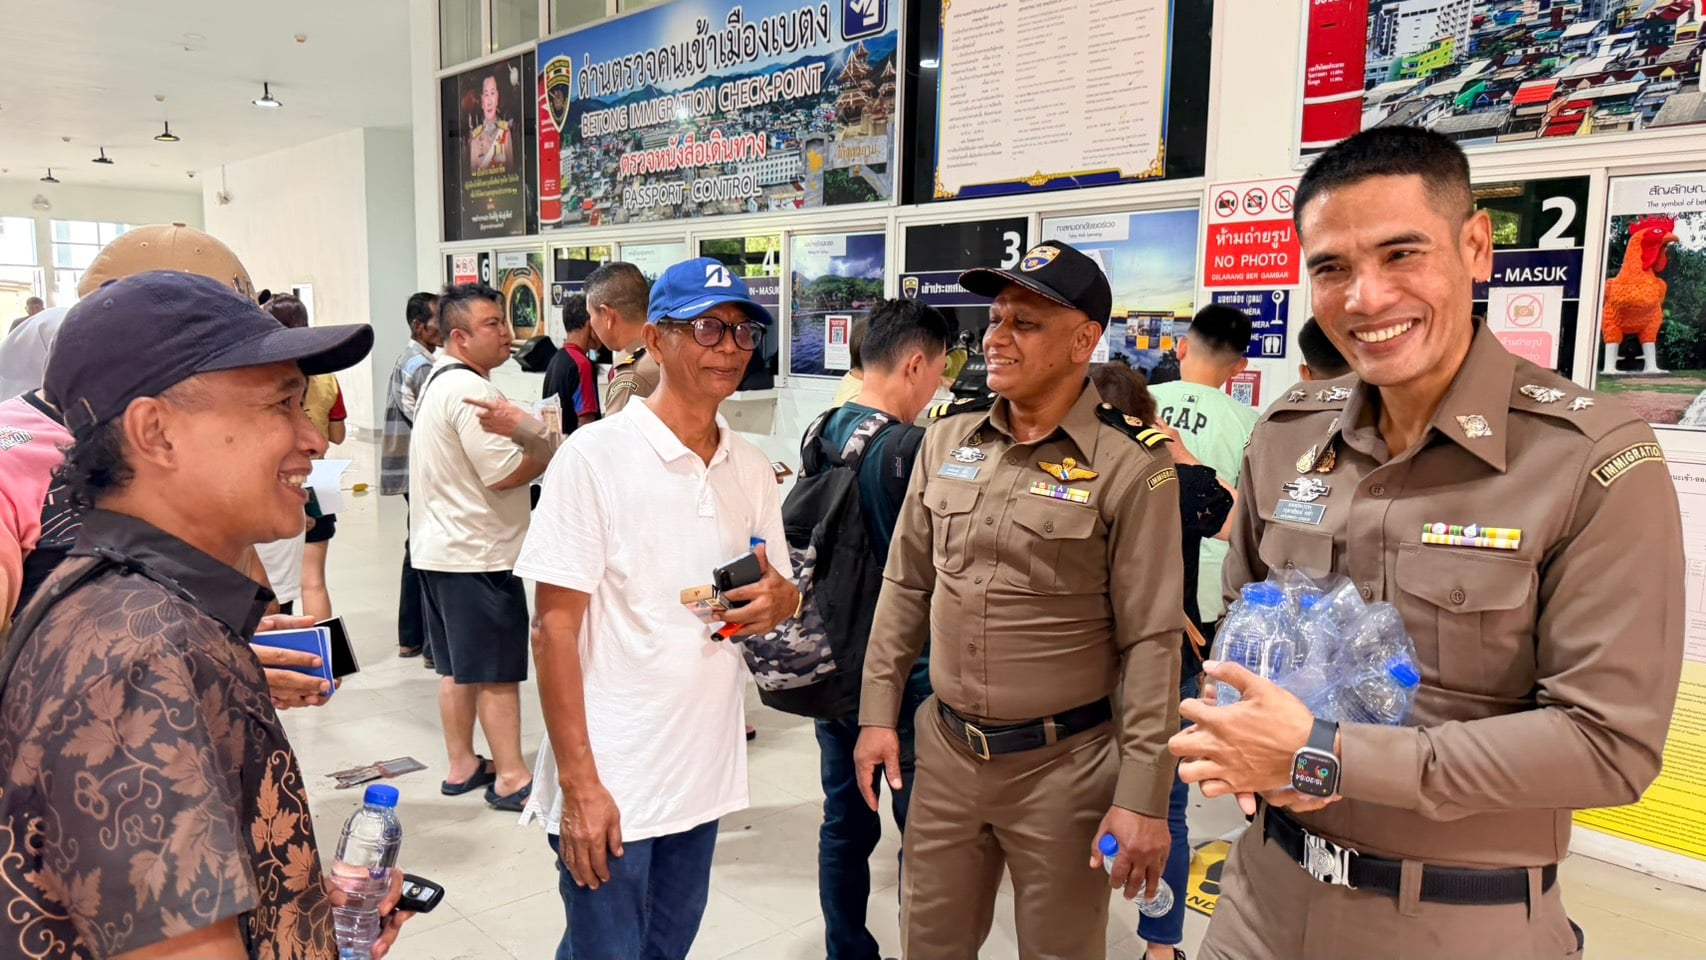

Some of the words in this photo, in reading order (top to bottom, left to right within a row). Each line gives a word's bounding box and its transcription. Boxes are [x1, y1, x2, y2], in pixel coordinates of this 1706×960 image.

[578, 3, 831, 100] ด่านตรวจคนเข้าเมืองเบตง
[581, 105, 628, 138] BETONG
[629, 85, 717, 129] IMMIGRATION
[719, 61, 825, 112] CHECK-POINT
[620, 129, 767, 177] ตรวจหนังสือเดินทาง
[623, 181, 685, 209] PASSPORT
[691, 173, 762, 201] CONTROL
[1662, 199, 1685, 209] symbol
[1687, 198, 1695, 206] of
[1216, 226, 1291, 249] ห้ามถ่ายรูป
[1539, 196, 1577, 249] 2
[762, 248, 775, 278] 4
[1000, 231, 1021, 270] 3
[1214, 255, 1235, 268] NO
[1241, 252, 1288, 267] PHOTO
[482, 259, 490, 282] 6
[1260, 271, 1289, 280] GAMBAR
[1505, 266, 1568, 282] MASUK
[1161, 406, 1208, 435] GAP
[1601, 446, 1661, 479] IMMIGRATIO
